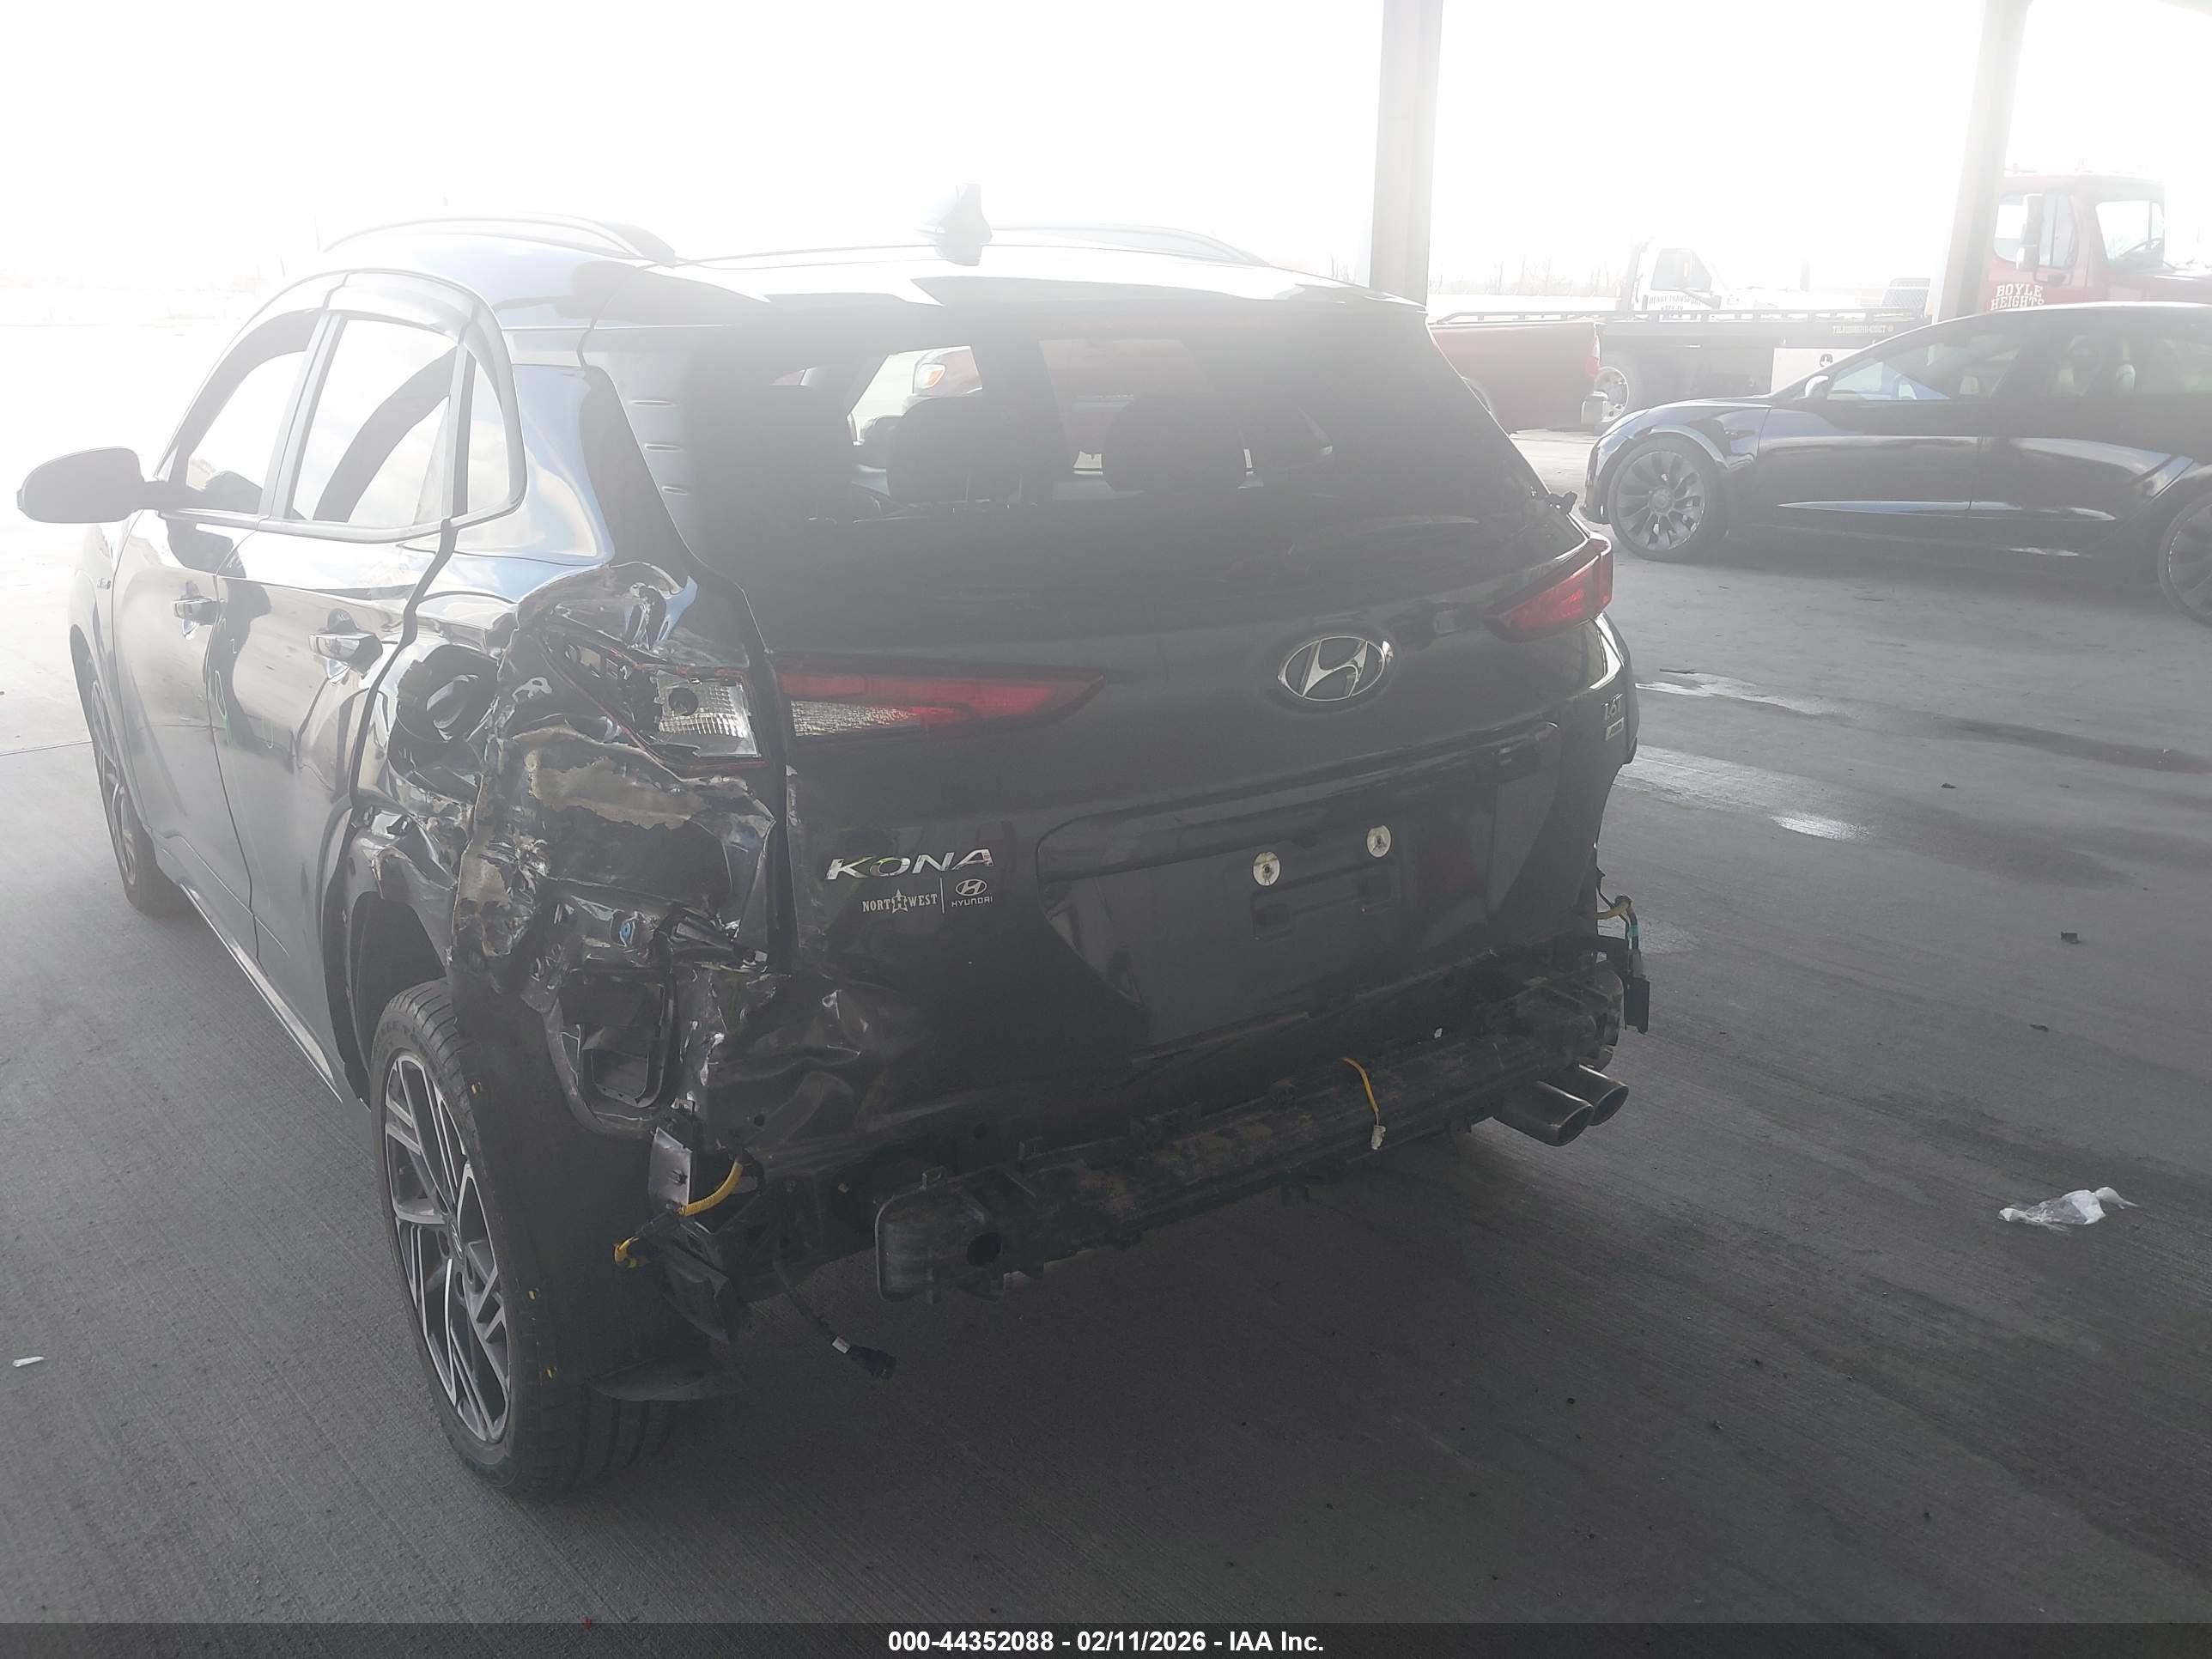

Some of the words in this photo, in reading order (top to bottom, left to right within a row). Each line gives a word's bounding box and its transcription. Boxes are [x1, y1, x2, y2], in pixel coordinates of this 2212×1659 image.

[1996, 283, 2044, 297] BOYLE
[824, 848, 994, 880] KONA
[951, 896, 994, 908] HYUNDAI
